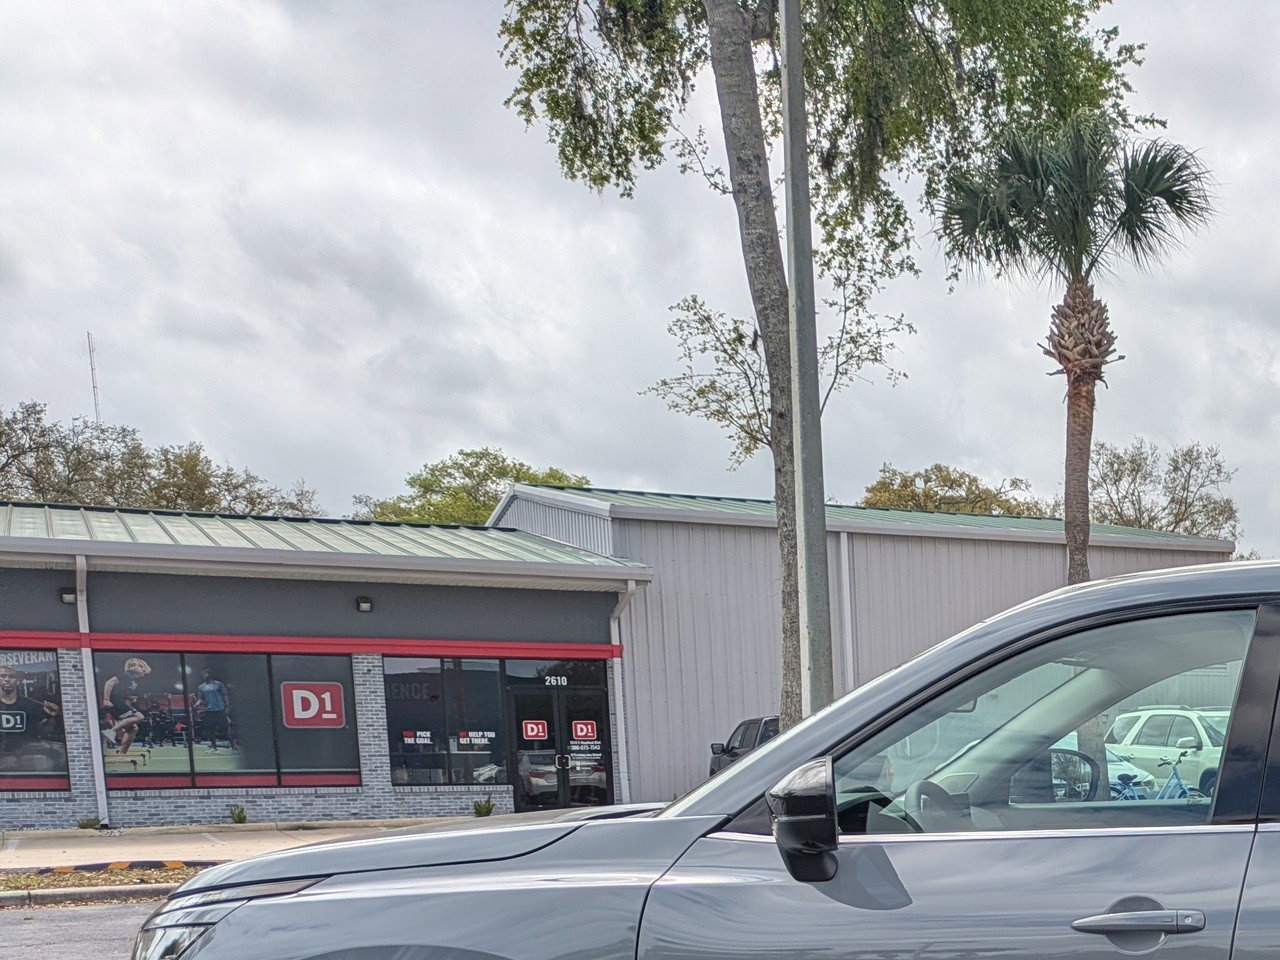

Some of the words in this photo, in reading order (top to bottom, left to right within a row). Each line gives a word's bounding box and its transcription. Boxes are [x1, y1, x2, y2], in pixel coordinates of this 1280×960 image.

[545, 676, 568, 686] 2610
[293, 689, 338, 719] D1
[1, 714, 23, 728] D1
[527, 723, 545, 736] D1
[576, 723, 594, 736] D1
